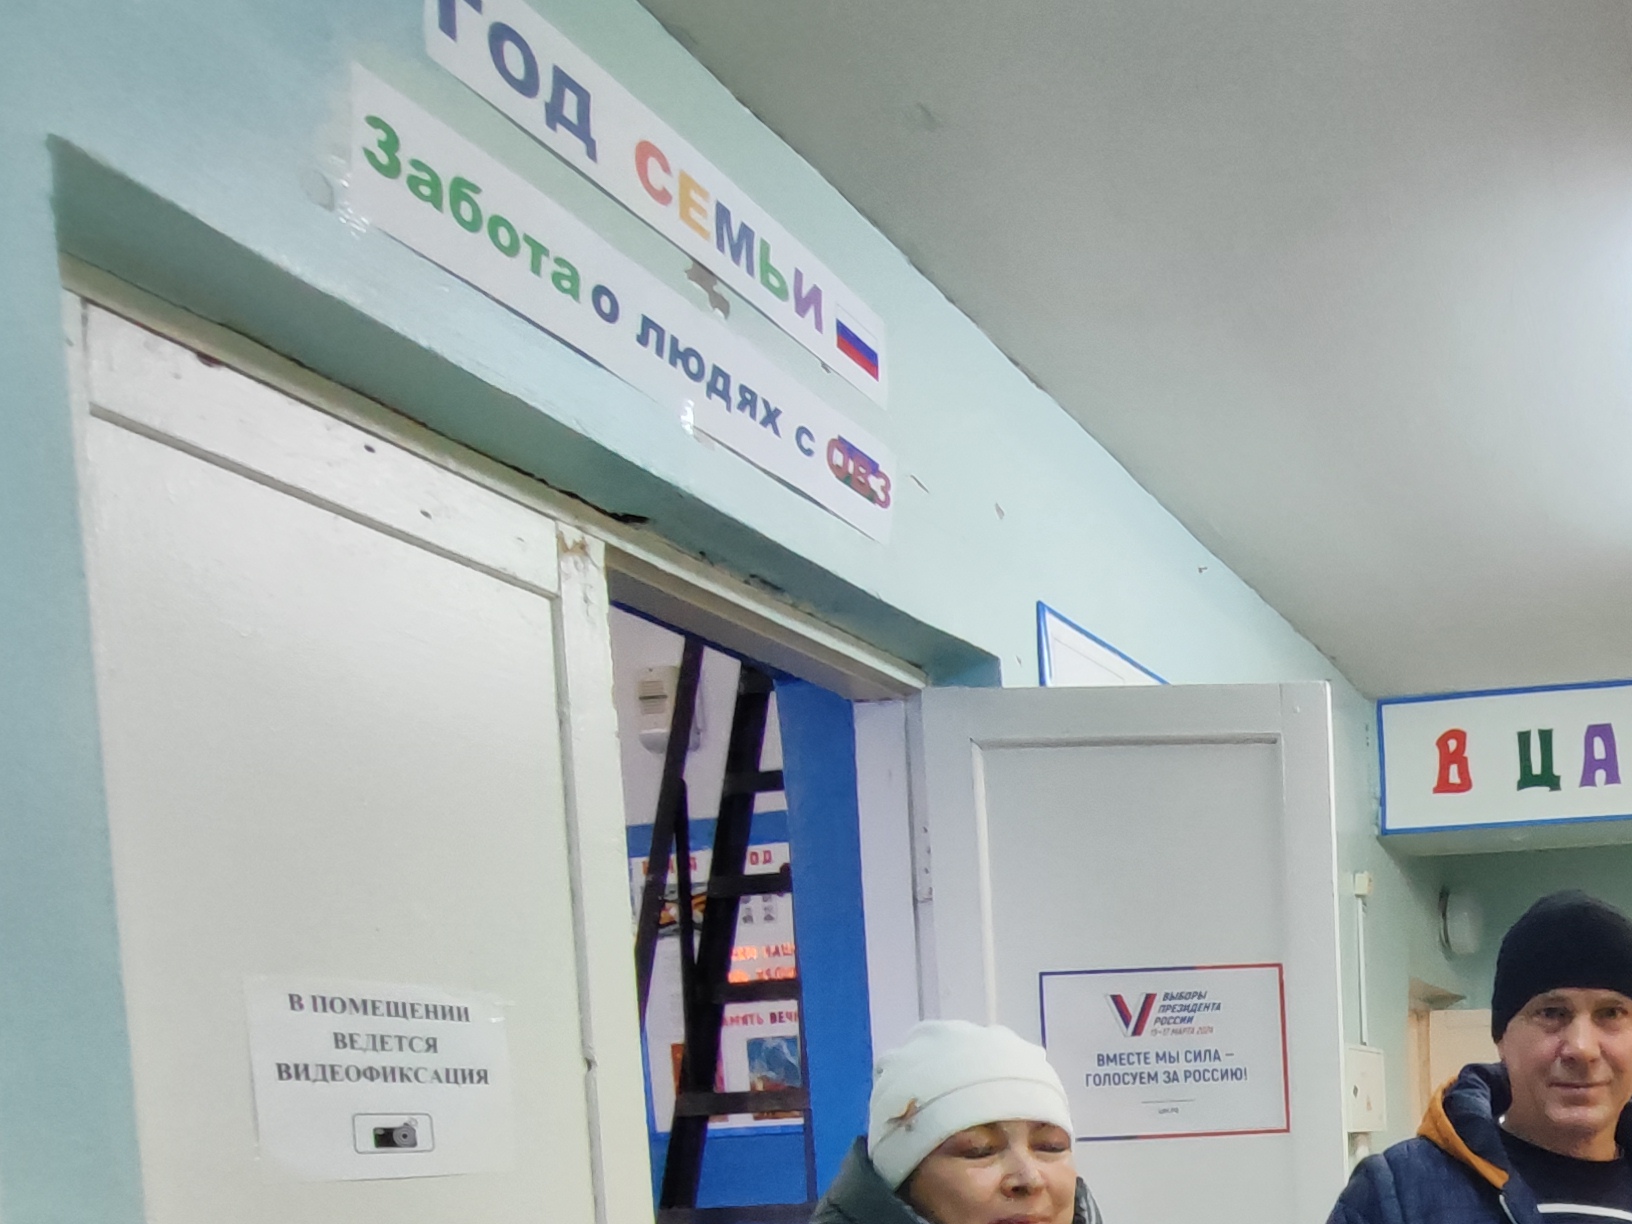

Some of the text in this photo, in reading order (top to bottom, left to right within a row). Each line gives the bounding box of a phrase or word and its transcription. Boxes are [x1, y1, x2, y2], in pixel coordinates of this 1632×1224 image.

[634, 140, 824, 334] СЕМЬИ
[362, 115, 891, 508] Забота о людях с ОВЗ
[1431, 727, 1472, 795] В
[1162, 990, 1207, 1001] ВЫБОРЫ
[288, 993, 471, 1023] В ПОМЕЩЕНИИ
[1158, 1002, 1221, 1013] ПРЕЗИДЕНТА
[1154, 1016, 1194, 1025] РОССИИ
[333, 1032, 439, 1053] ВЕДЕТСЯ
[1097, 1052, 1151, 1067] ВМЕСТЕ
[1155, 1051, 1180, 1064] МЫ
[1184, 1049, 1221, 1063] СИЛА
[275, 1062, 490, 1086] ВИДЕОФИКСАЦИЯ
[1085, 1067, 1248, 1087] ГОЛОСУЕМ ЗА РОССИЮ!
